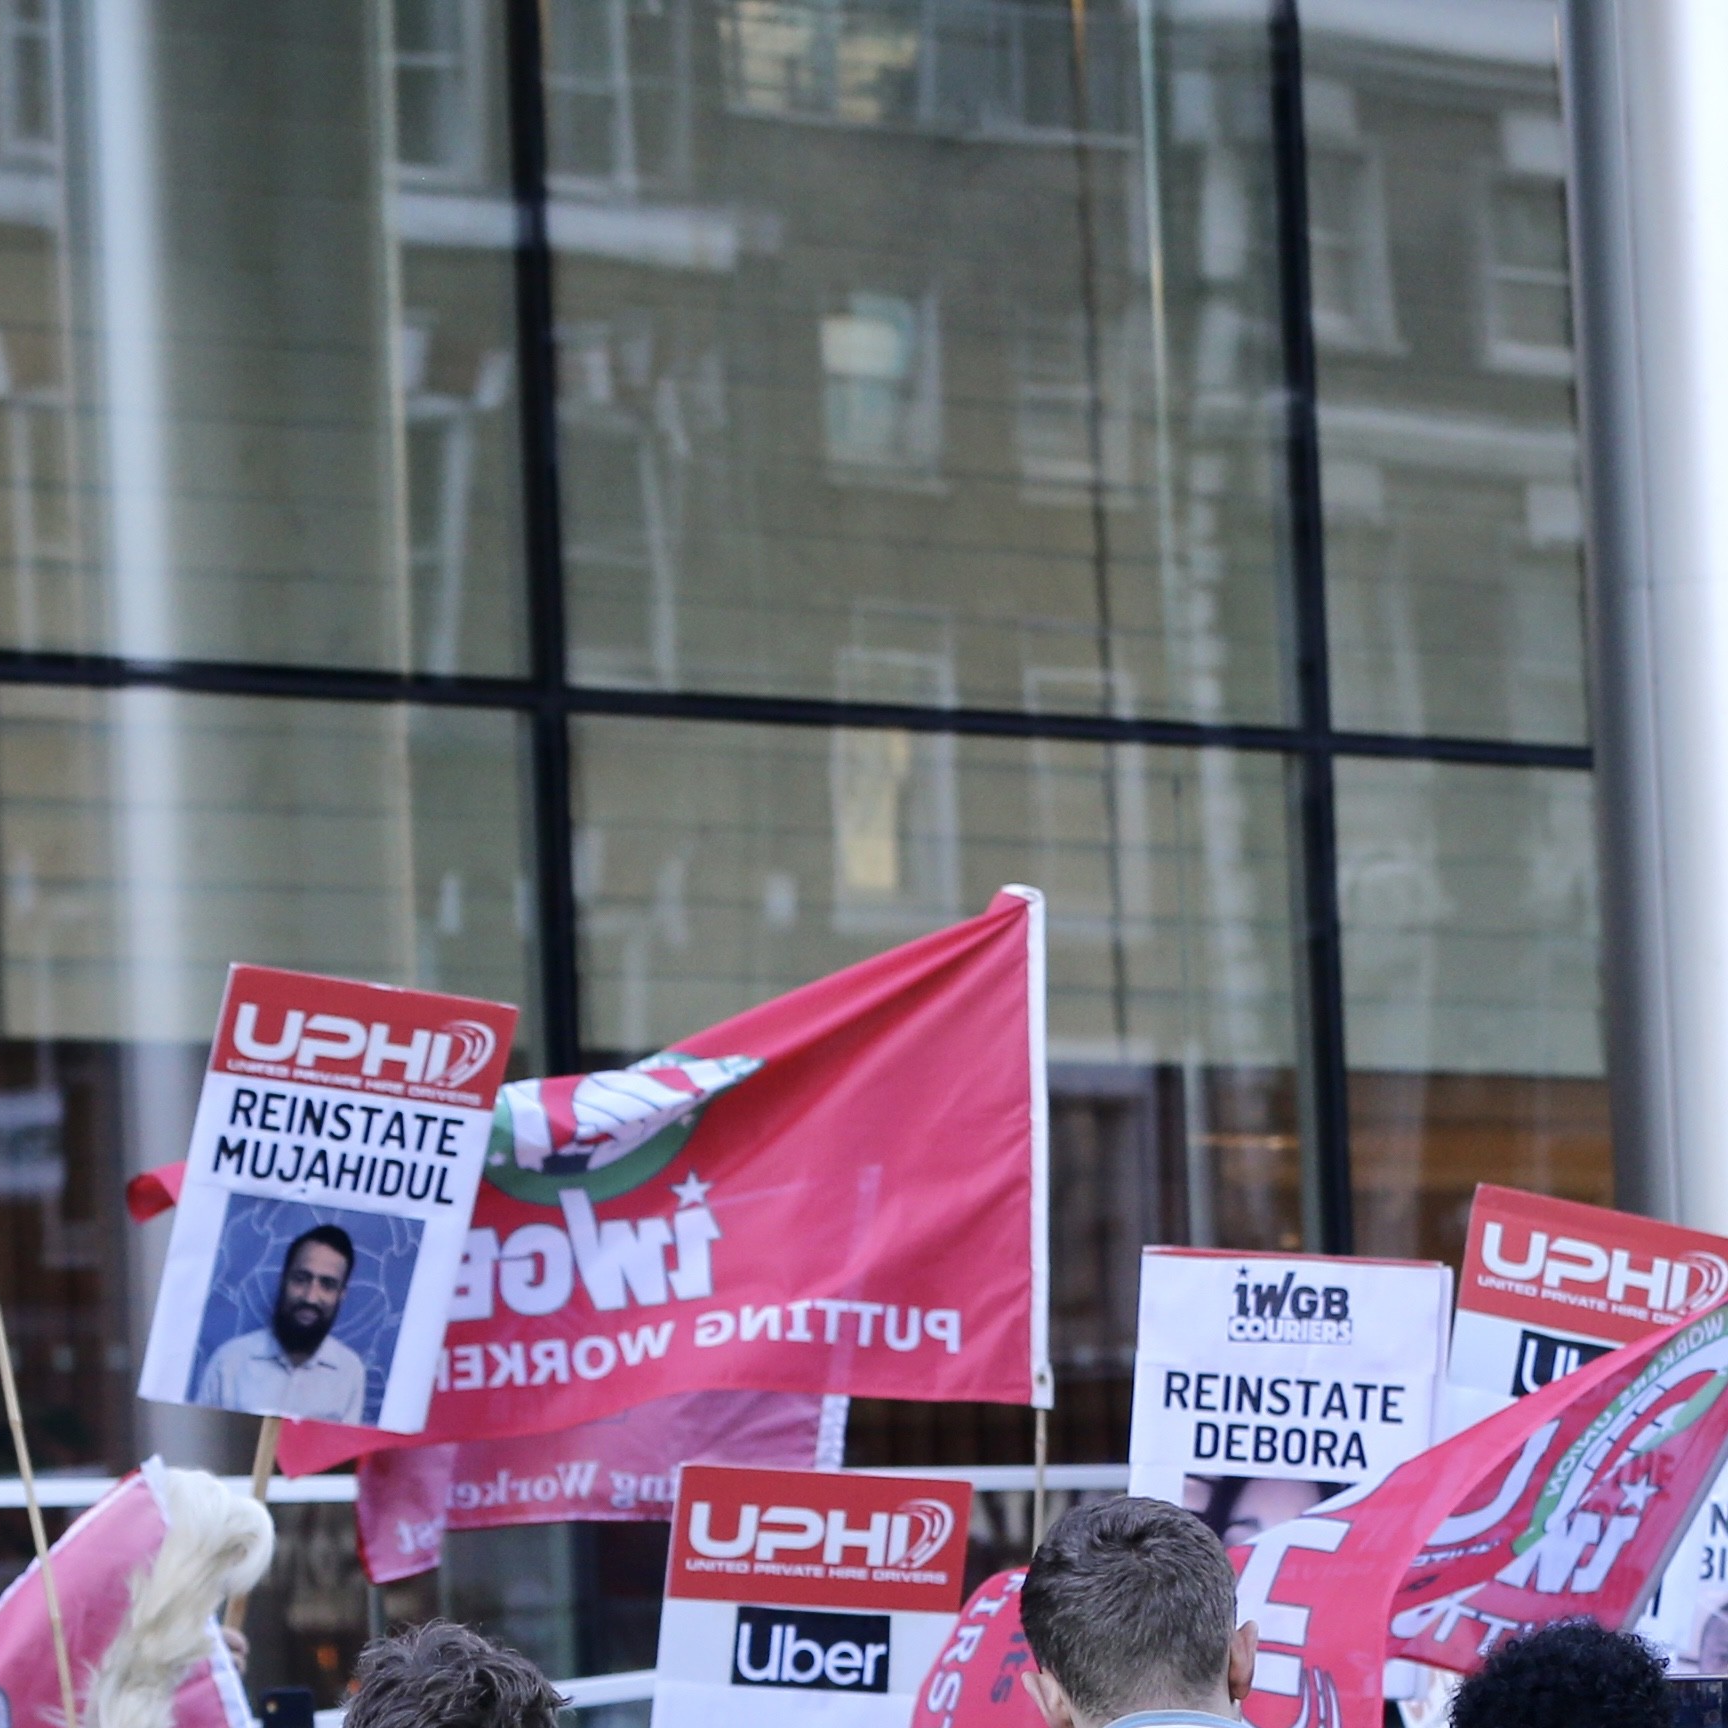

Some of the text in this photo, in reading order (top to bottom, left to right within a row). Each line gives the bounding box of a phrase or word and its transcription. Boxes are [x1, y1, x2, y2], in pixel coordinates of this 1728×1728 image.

[229, 1088, 466, 1157] REINSTATE
[213, 1135, 453, 1205] MUJAHIDUL
[1477, 1275, 1538, 1298] UNITED
[1540, 1288, 1608, 1312] PRIVATE
[1611, 1302, 1649, 1321] HIRE
[1228, 1316, 1352, 1344] COURIERS
[1164, 1370, 1405, 1424] REINSTATE
[1193, 1421, 1367, 1469] DEBORA
[685, 1558, 948, 1586] UNITED PRIVATE HIRE DRIVERS
[737, 1623, 888, 1687] Uber
